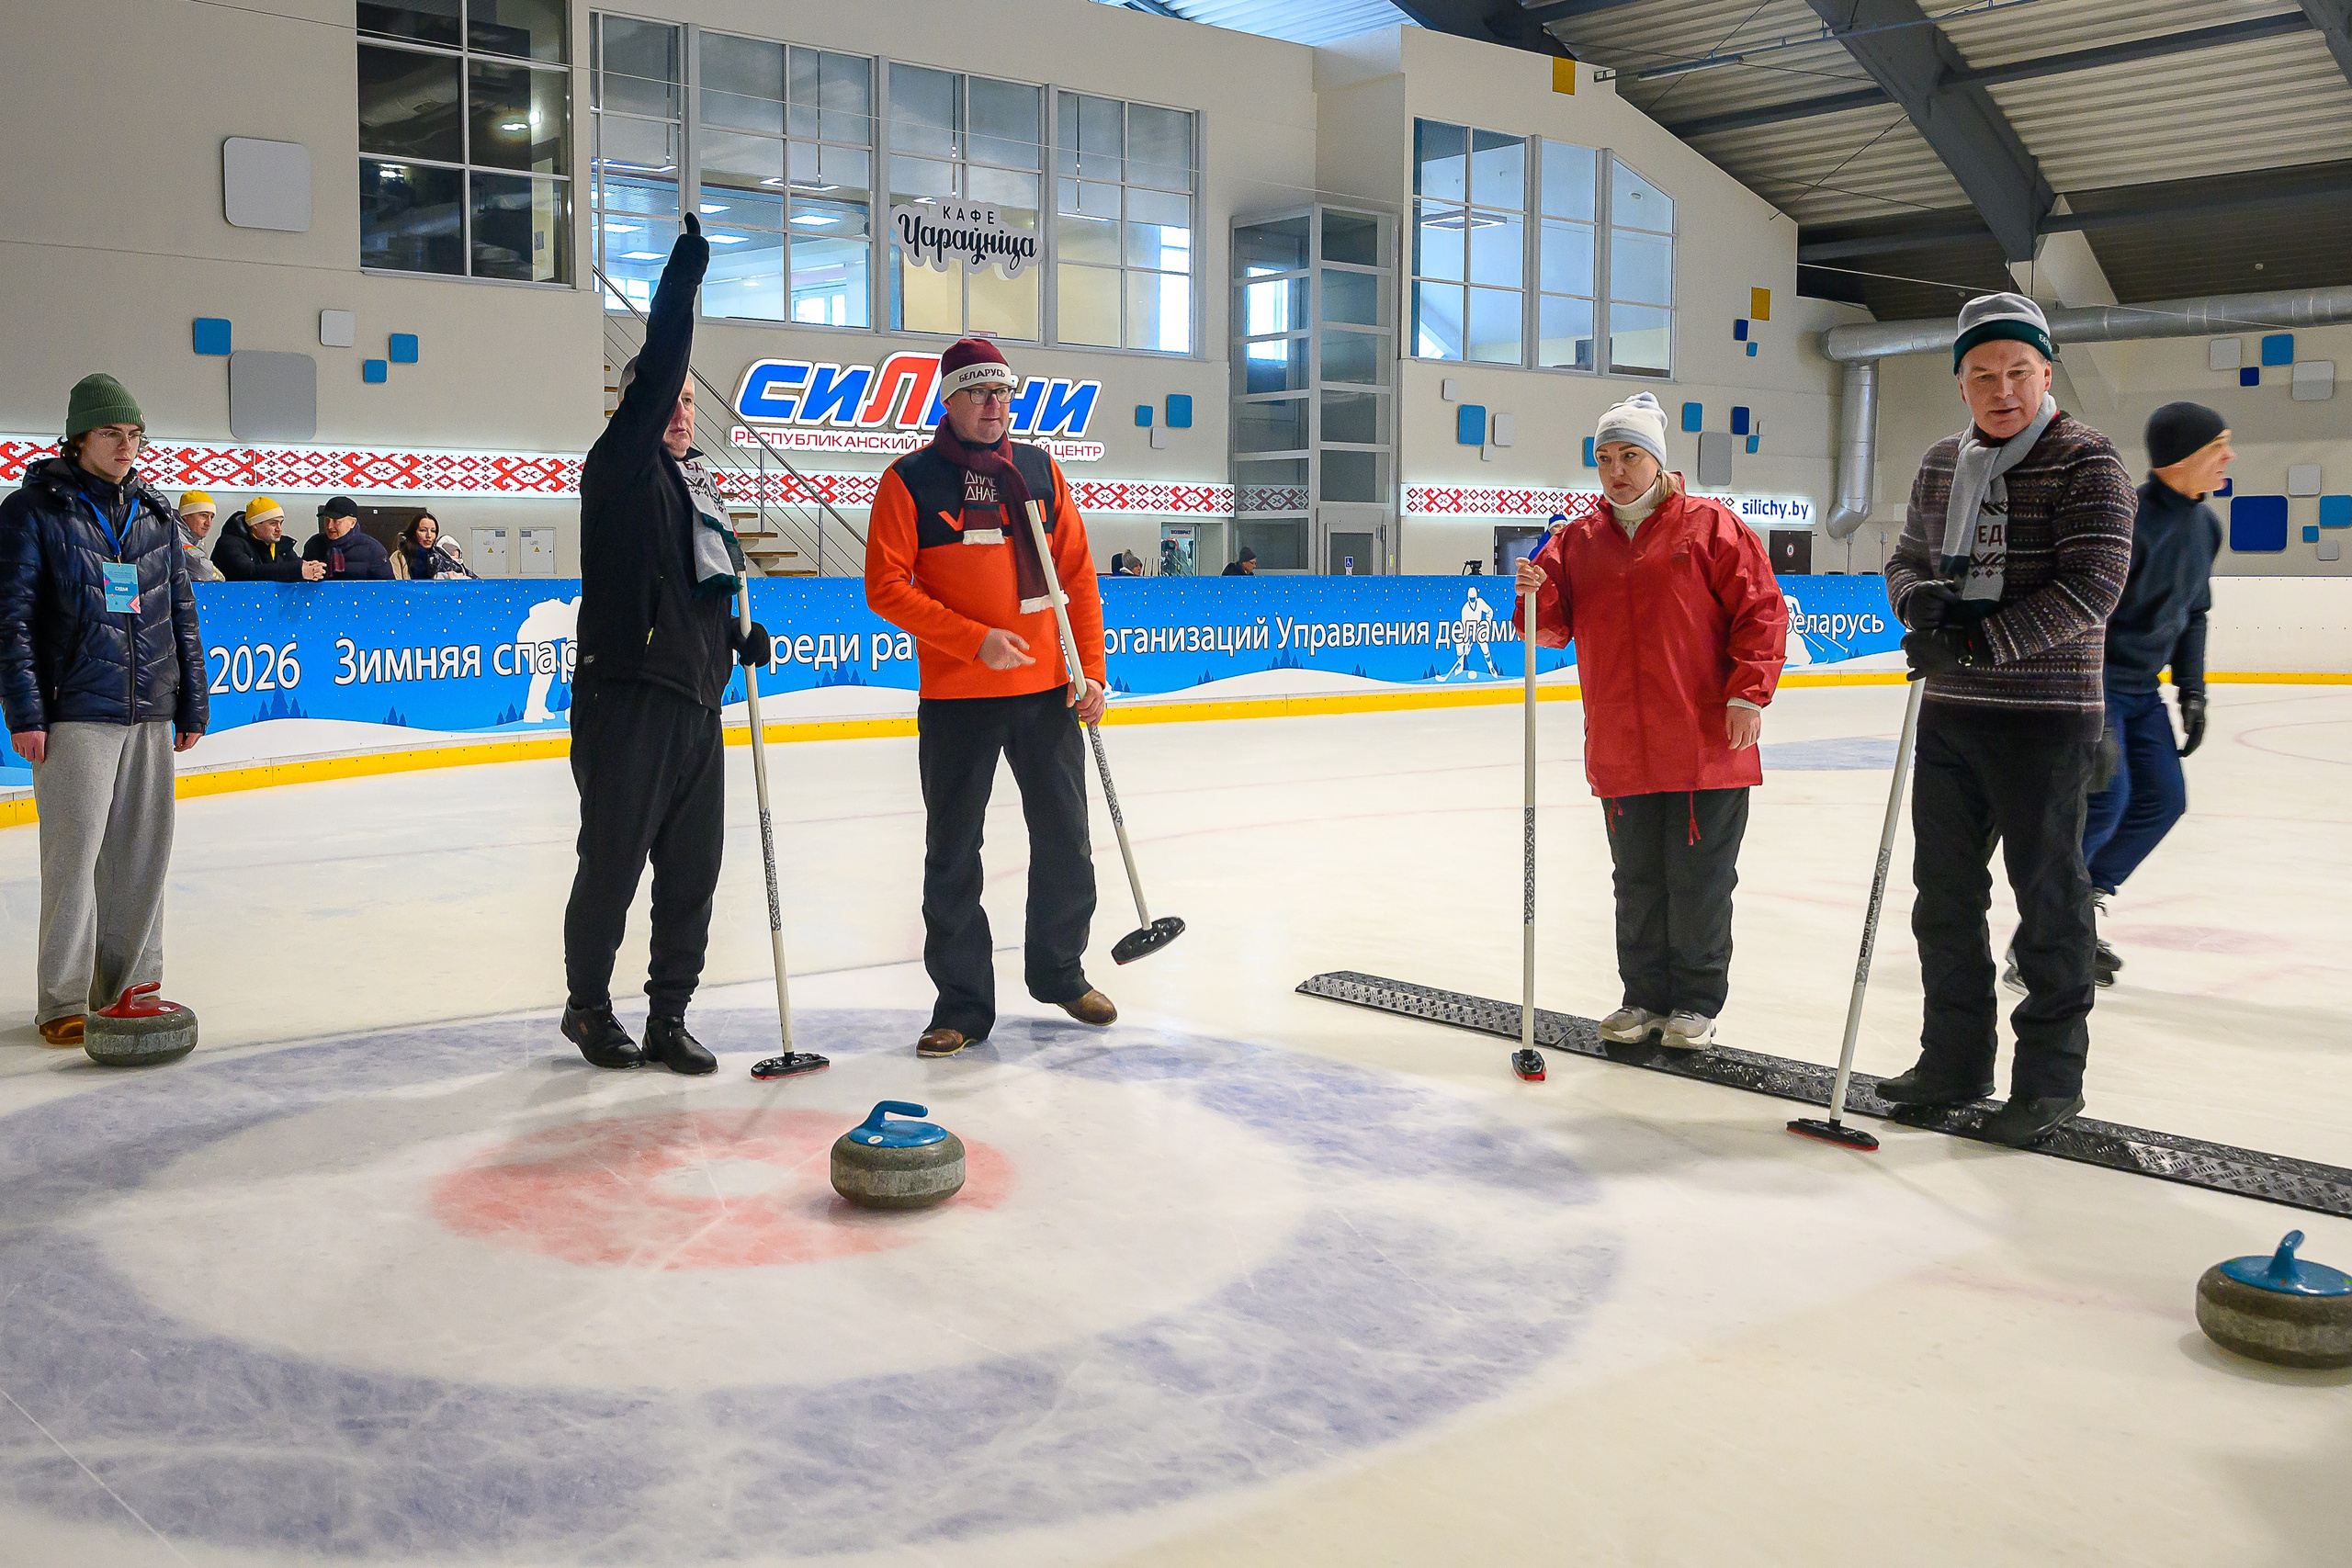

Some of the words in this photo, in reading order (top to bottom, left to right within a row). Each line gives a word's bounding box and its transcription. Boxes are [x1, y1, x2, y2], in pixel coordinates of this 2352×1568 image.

[943, 205, 995, 225] КАФЕ
[898, 213, 1037, 271] Чараўніца
[736, 352, 1101, 436] СИЛЧИ
[958, 368, 1006, 382] БЕЛАРУСЬ
[734, 430, 917, 450] РЕСПУБЛИКАНСКИЙ
[1054, 445, 1102, 457] ЦЕНТР
[1742, 499, 1809, 520] silichy.by
[208, 641, 302, 695] 2026
[334, 637, 482, 685] Зимняя
[492, 639, 578, 684] спар
[769, 632, 861, 675] реди
[1103, 615, 1270, 660] рганизаций
[1275, 615, 1430, 657] Управления
